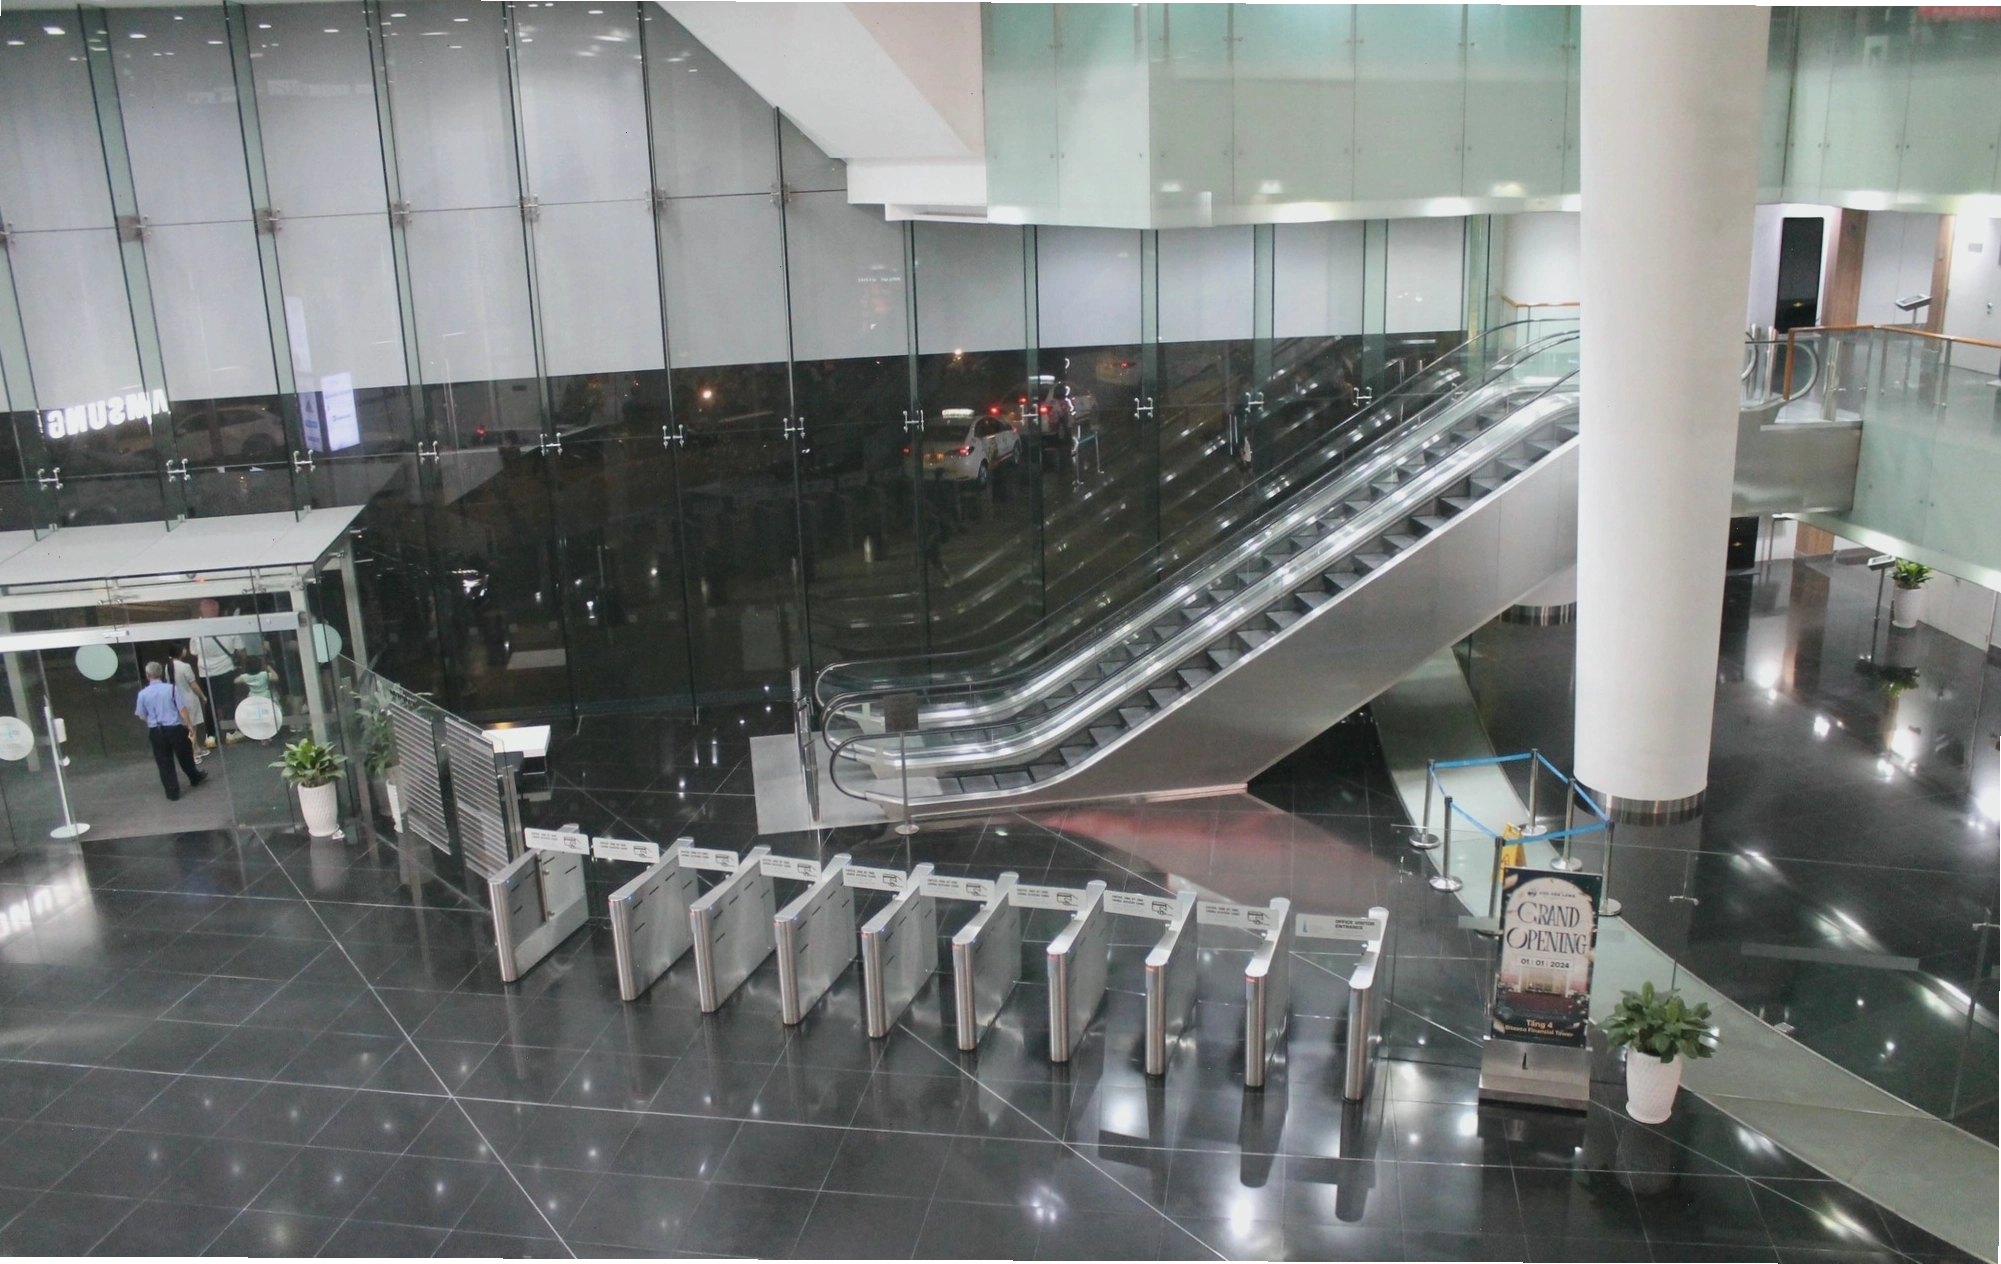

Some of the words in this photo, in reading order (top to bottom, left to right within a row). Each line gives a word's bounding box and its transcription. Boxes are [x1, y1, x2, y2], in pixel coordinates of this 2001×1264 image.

[1517, 901, 1580, 928] GRAND
[1506, 927, 1588, 955] OPENING
[1550, 961, 1570, 969] 2024
